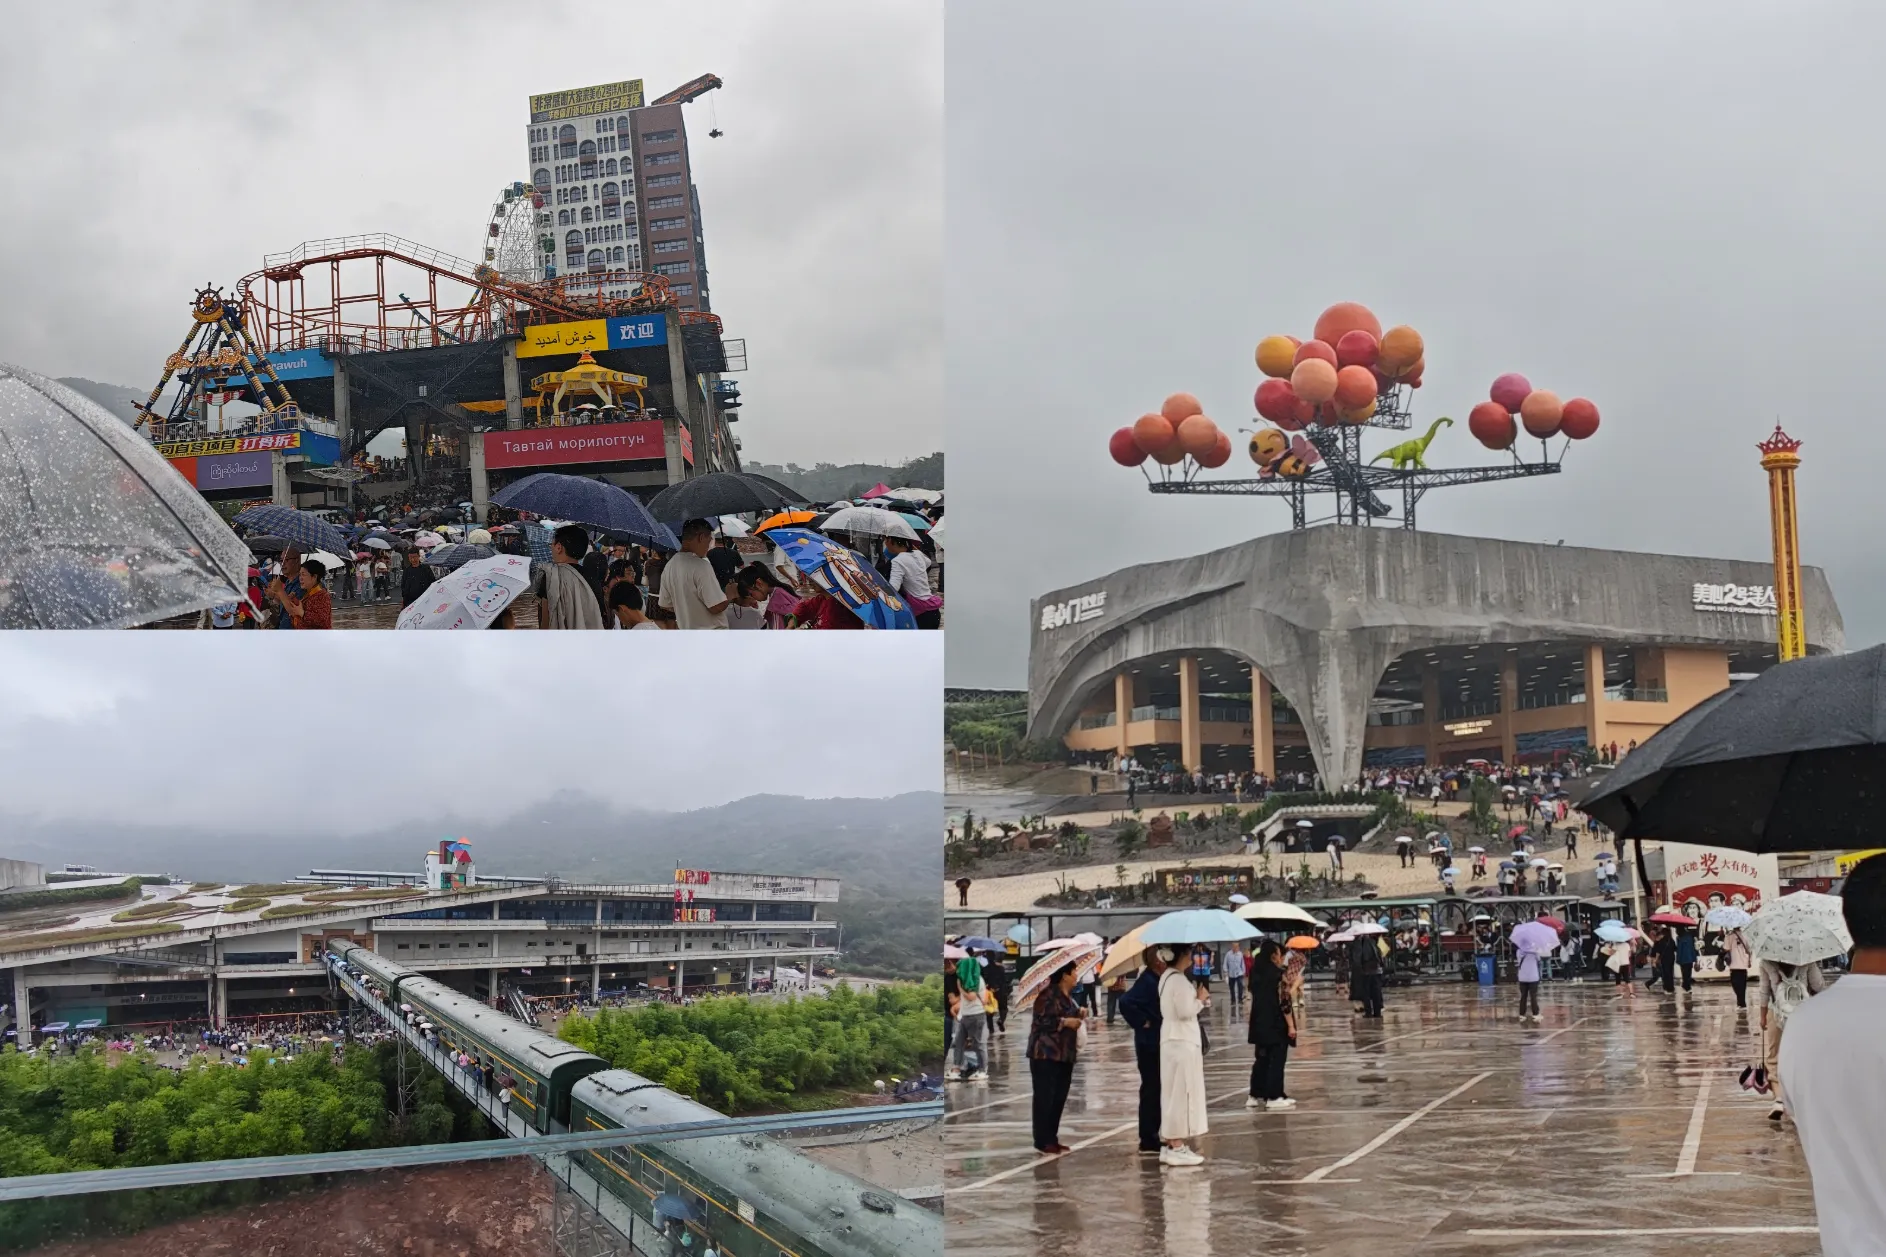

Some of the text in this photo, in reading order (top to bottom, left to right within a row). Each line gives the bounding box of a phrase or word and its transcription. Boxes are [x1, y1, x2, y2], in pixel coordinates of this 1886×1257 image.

[564, 330, 596, 346] خوش
[619, 322, 654, 341] 欢迎
[242, 434, 292, 450] 打骨折
[502, 434, 645, 453] Тавтай морилогтун
